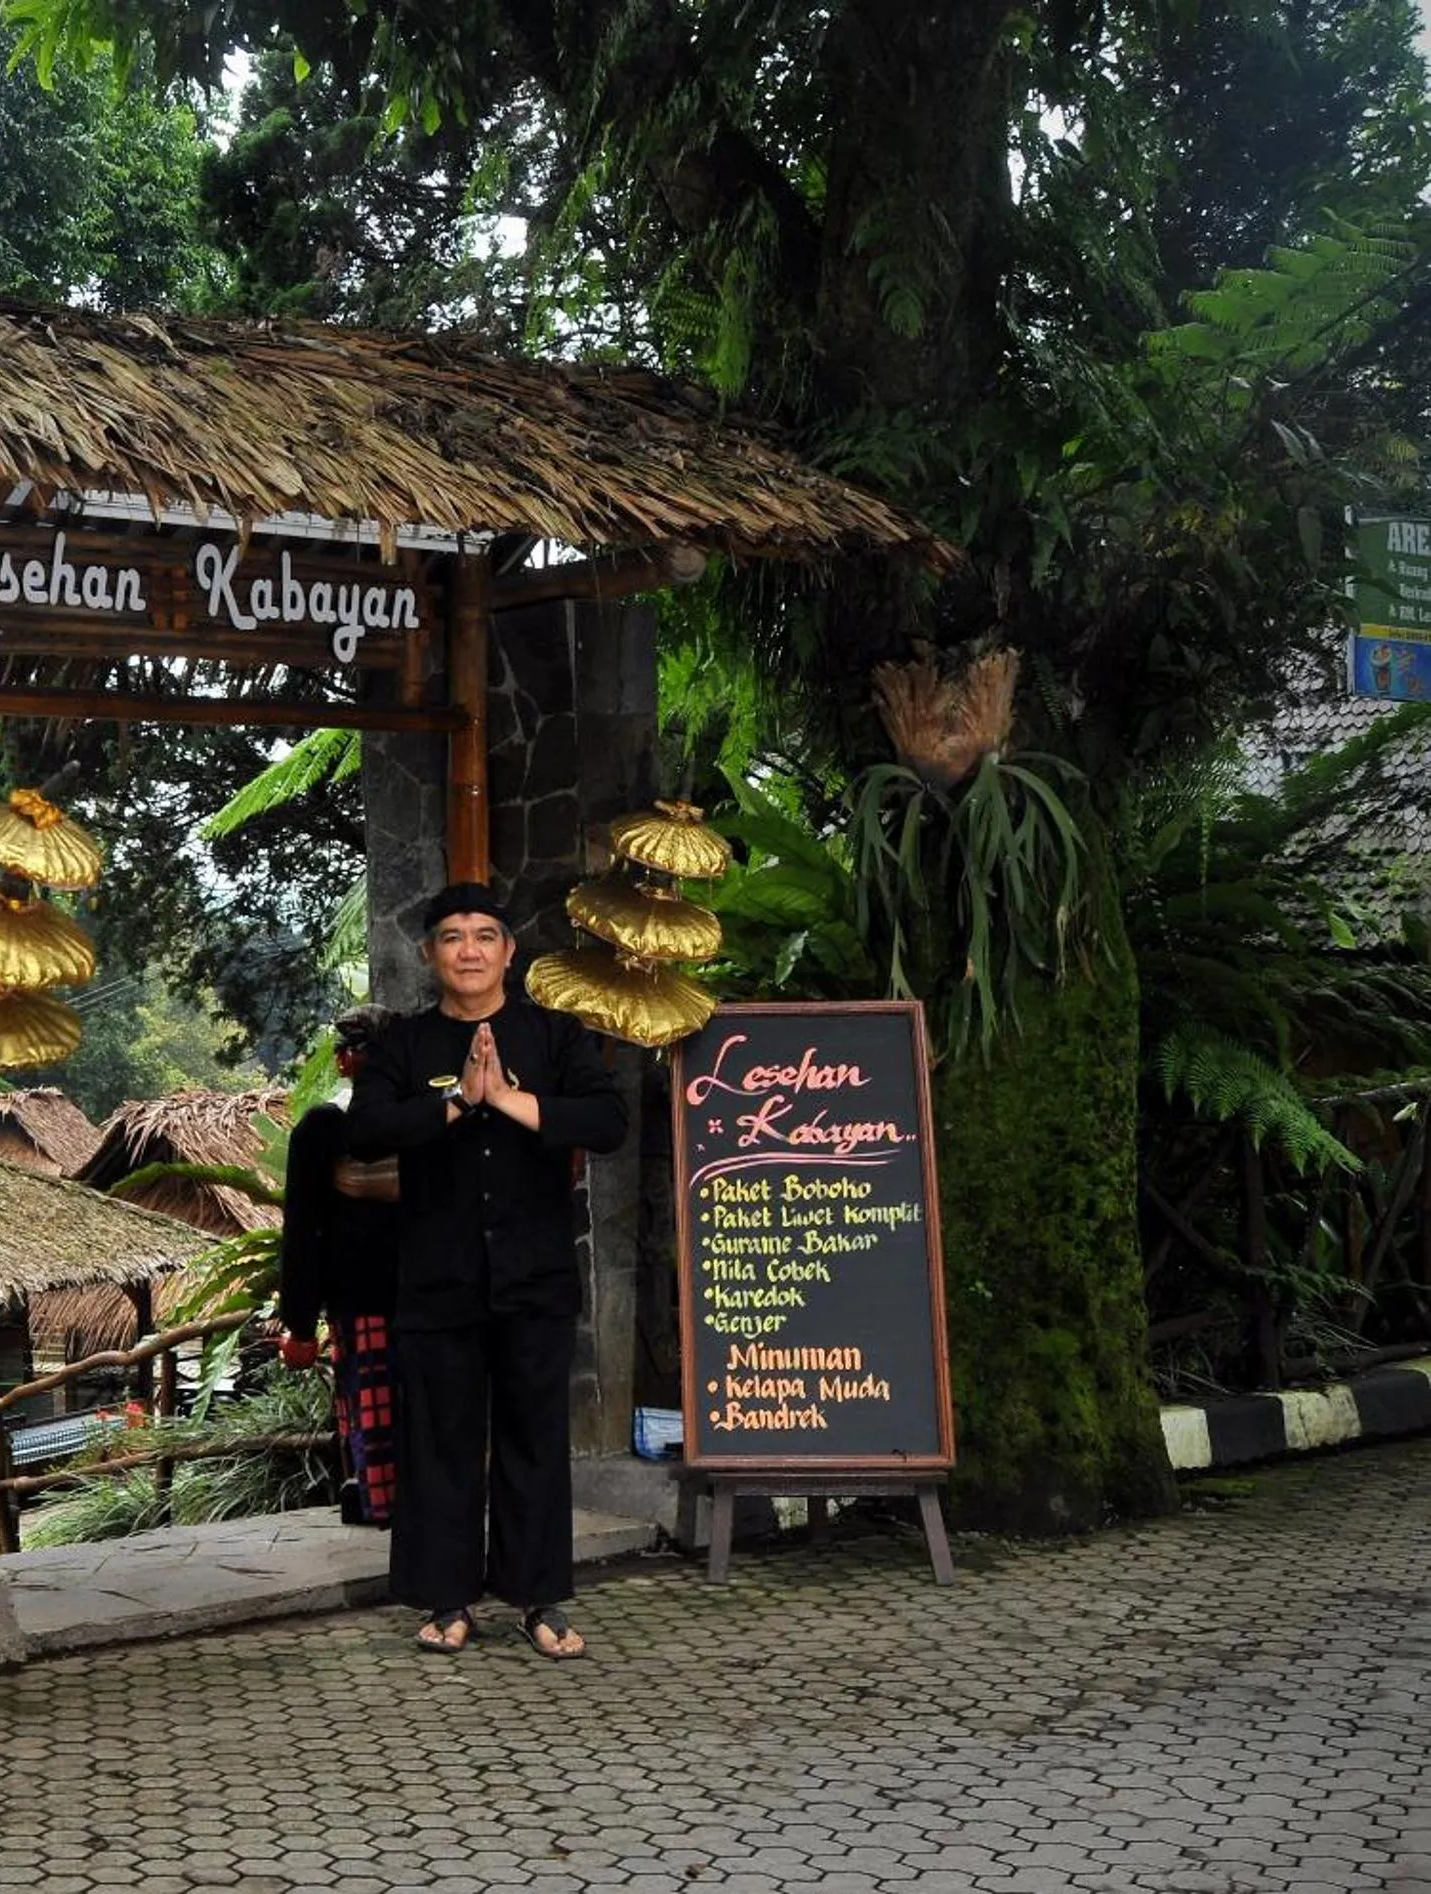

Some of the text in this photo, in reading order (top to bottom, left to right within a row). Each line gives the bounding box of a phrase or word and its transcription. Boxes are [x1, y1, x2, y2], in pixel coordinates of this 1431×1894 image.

[196, 542, 420, 663] Kabayan
[686, 1034, 873, 1105] Lesehan
[712, 1177, 772, 1203] Paket
[713, 1204, 772, 1228] Paket
[798, 1229, 878, 1255] Bakar
[767, 1259, 831, 1283] Cobek
[715, 1285, 806, 1308] Karedok
[714, 1312, 787, 1340] Genjer
[726, 1341, 862, 1371] Minuman
[726, 1372, 891, 1404] Kelapa Muda
[714, 1401, 828, 1431] Bandrek
